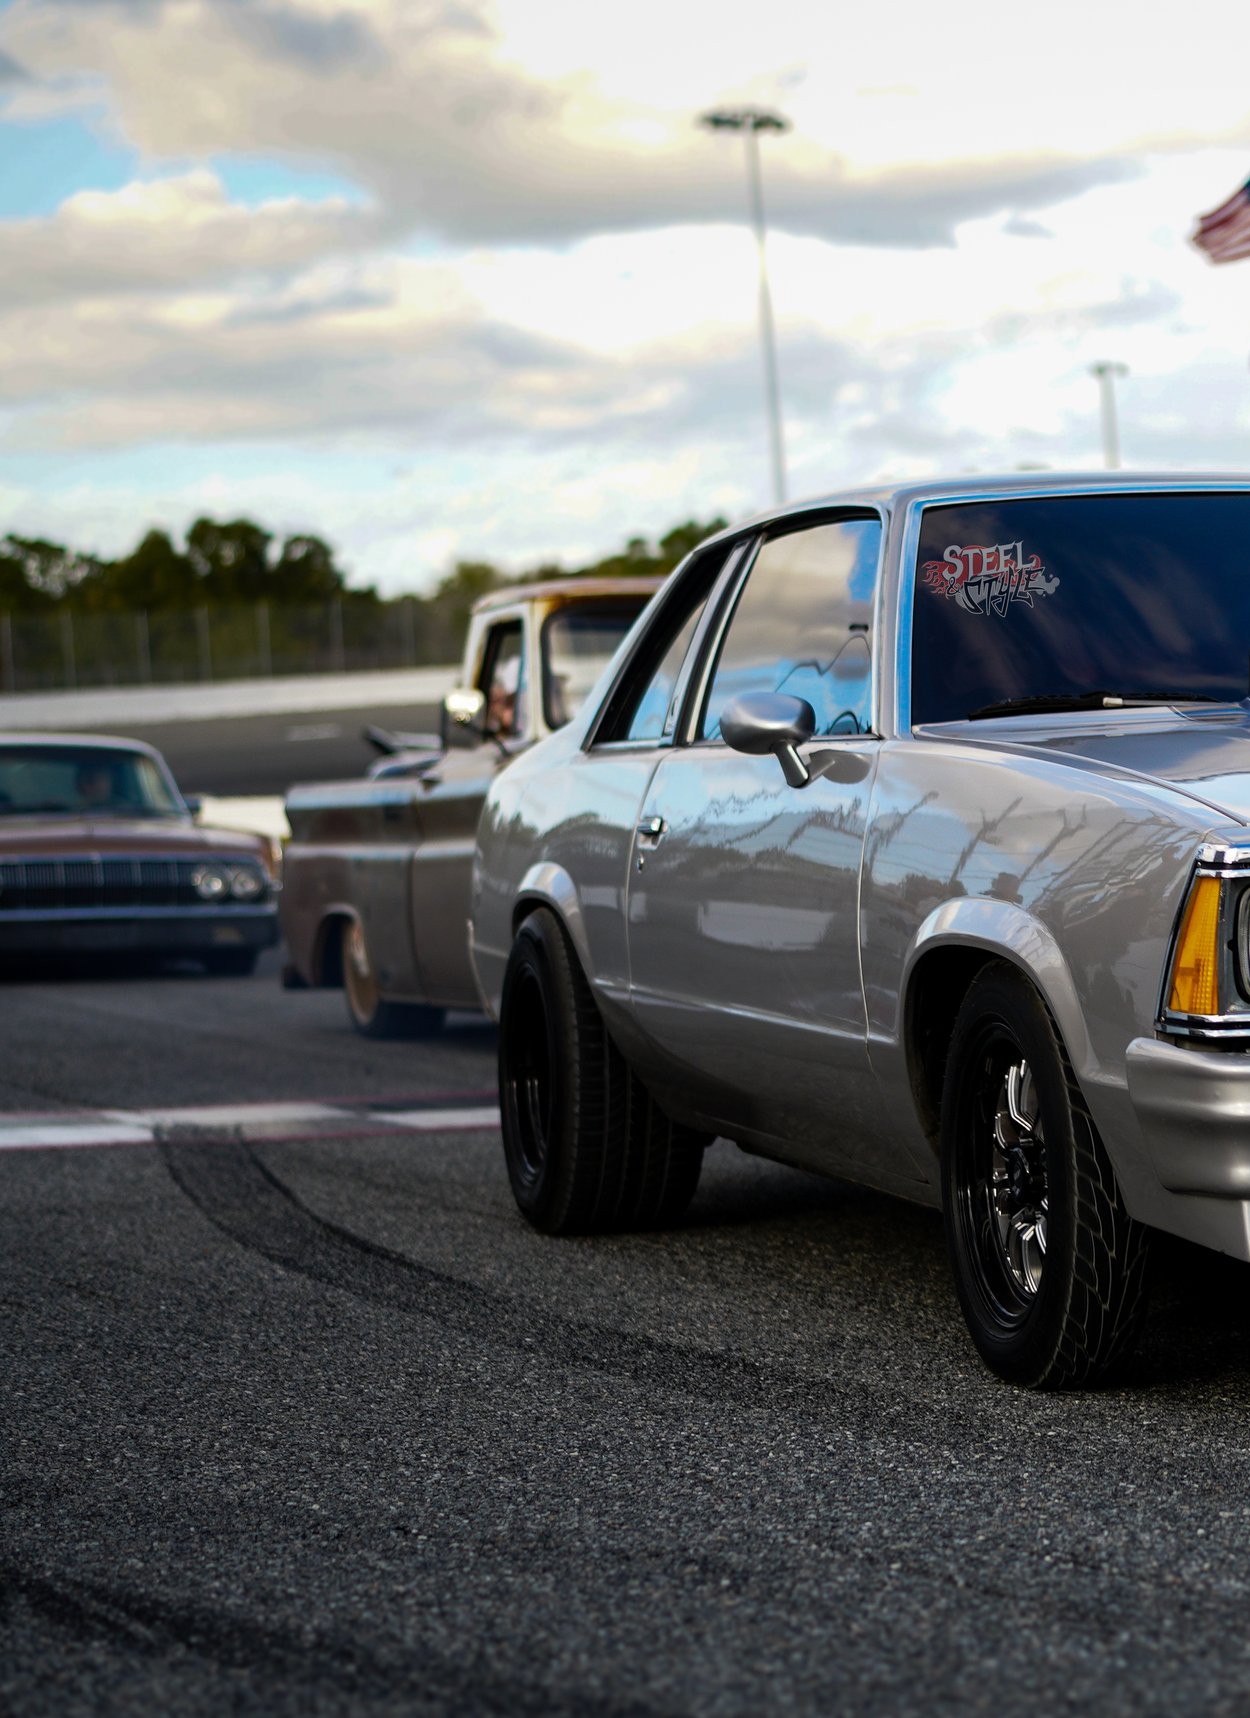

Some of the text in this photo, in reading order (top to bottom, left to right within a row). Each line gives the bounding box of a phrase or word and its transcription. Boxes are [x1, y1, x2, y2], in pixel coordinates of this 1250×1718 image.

[942, 540, 1036, 581] STEEL
[947, 565, 1046, 618] & STYLE
